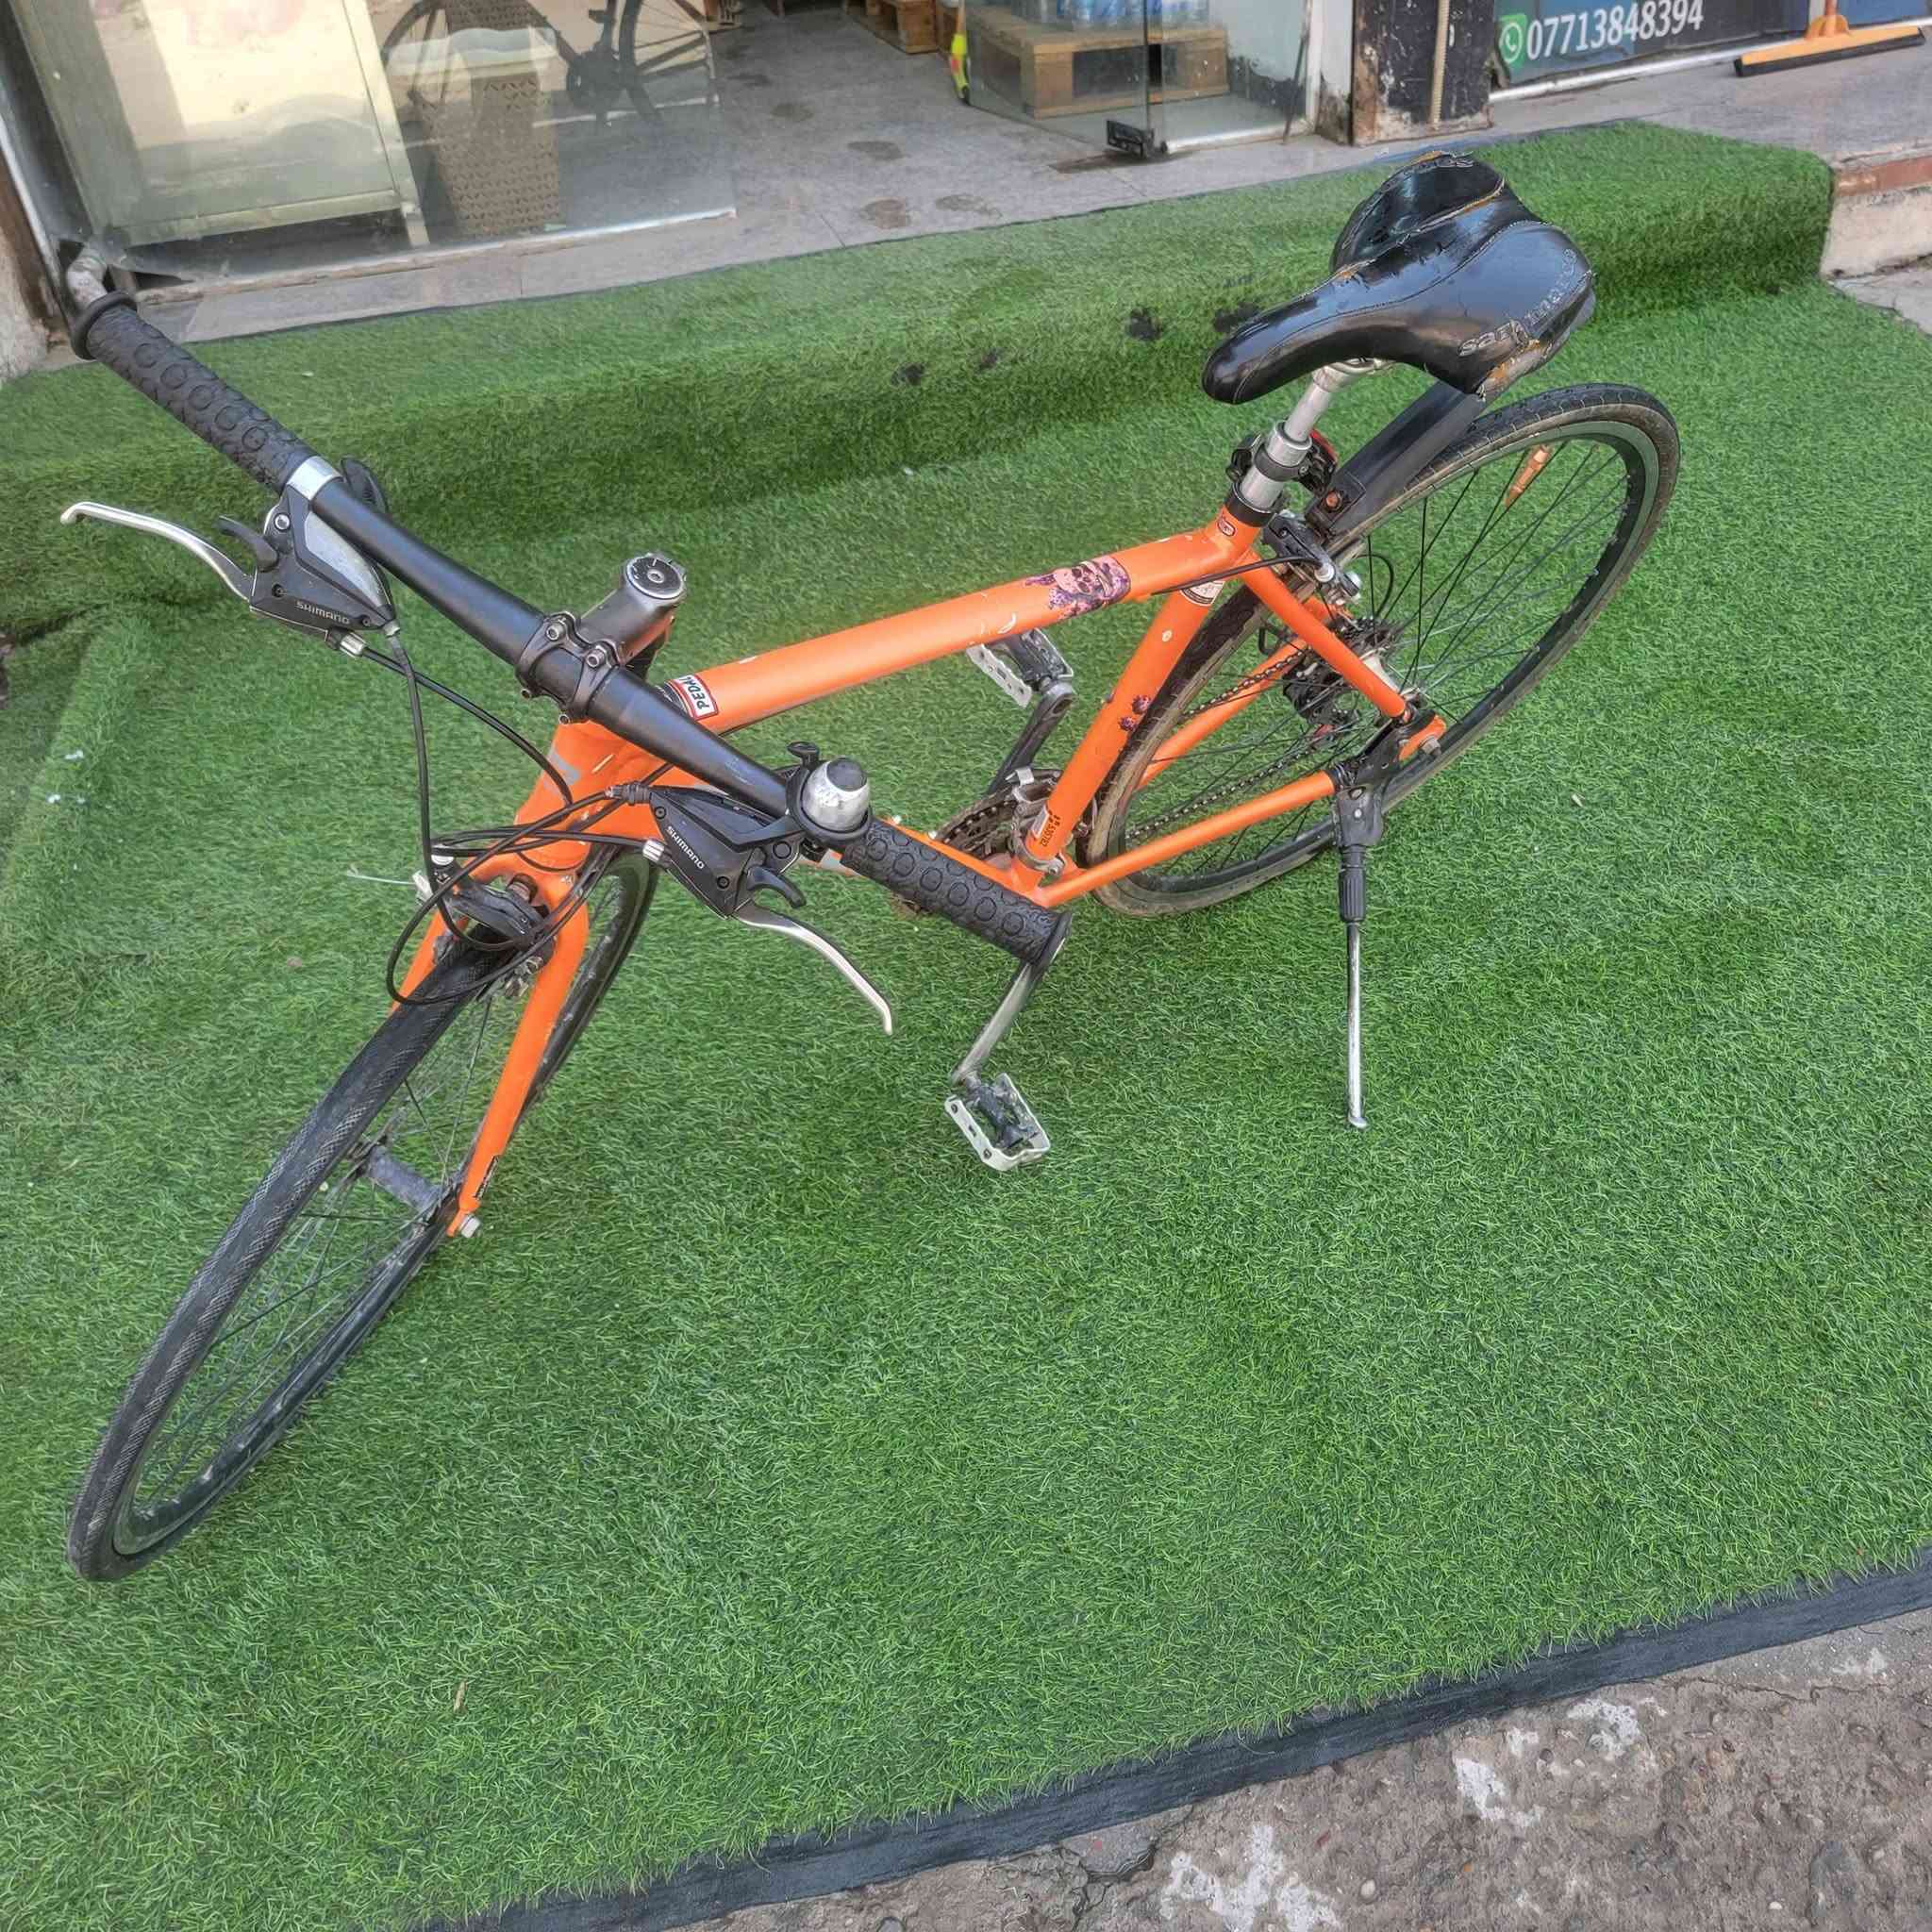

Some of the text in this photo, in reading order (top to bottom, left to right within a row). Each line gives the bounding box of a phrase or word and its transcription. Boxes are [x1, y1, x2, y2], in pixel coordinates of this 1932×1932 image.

[1526, 0, 1705, 60] 07713848394
[296, 601, 350, 625] SHIMANO
[667, 824, 706, 871] SHIMANO
